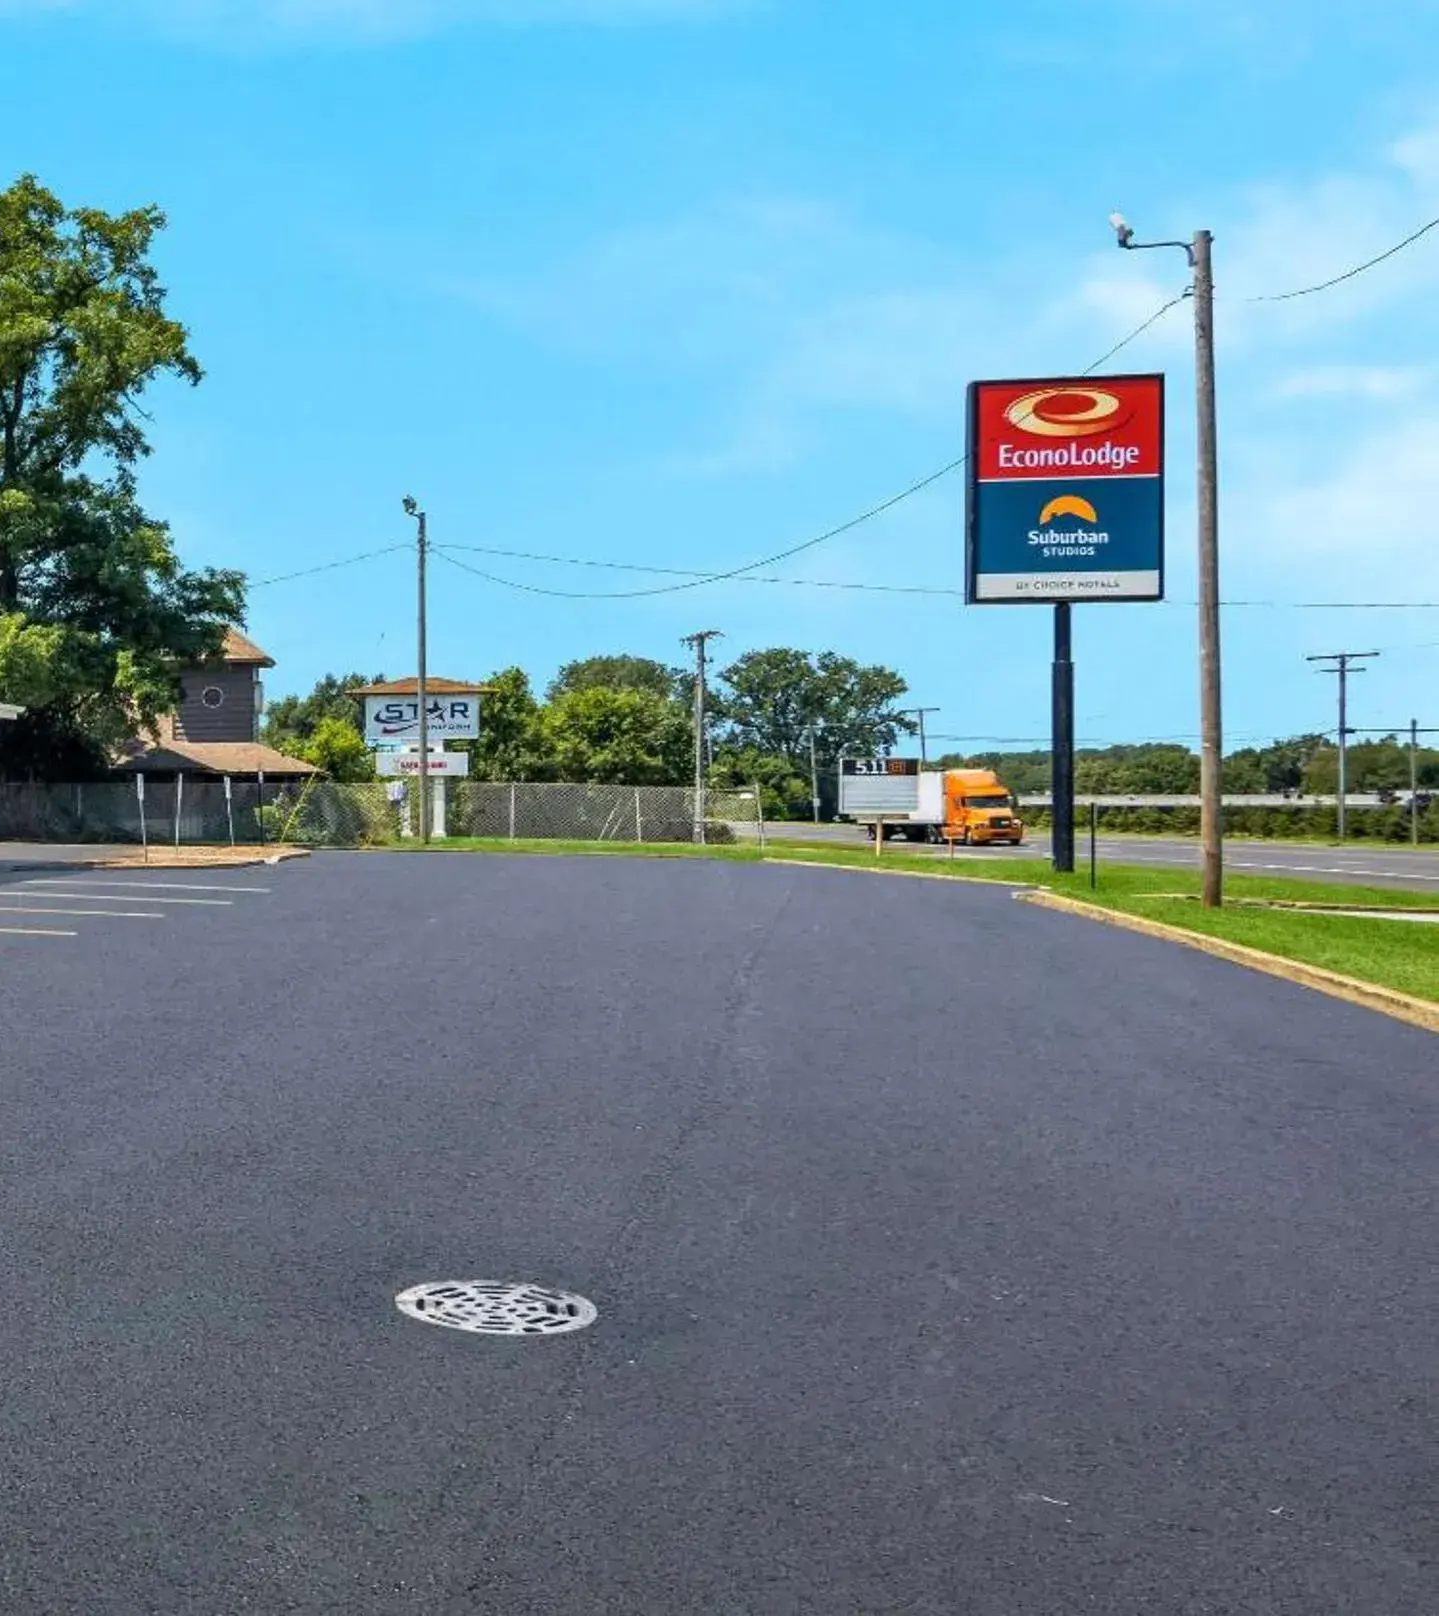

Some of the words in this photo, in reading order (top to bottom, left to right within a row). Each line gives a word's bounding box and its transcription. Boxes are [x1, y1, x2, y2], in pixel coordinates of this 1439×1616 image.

[998, 440, 1140, 469] EconoLodge
[1027, 529, 1109, 545] Suburban
[1043, 546, 1095, 557] STUDIOS
[854, 760, 889, 775] 5.11
